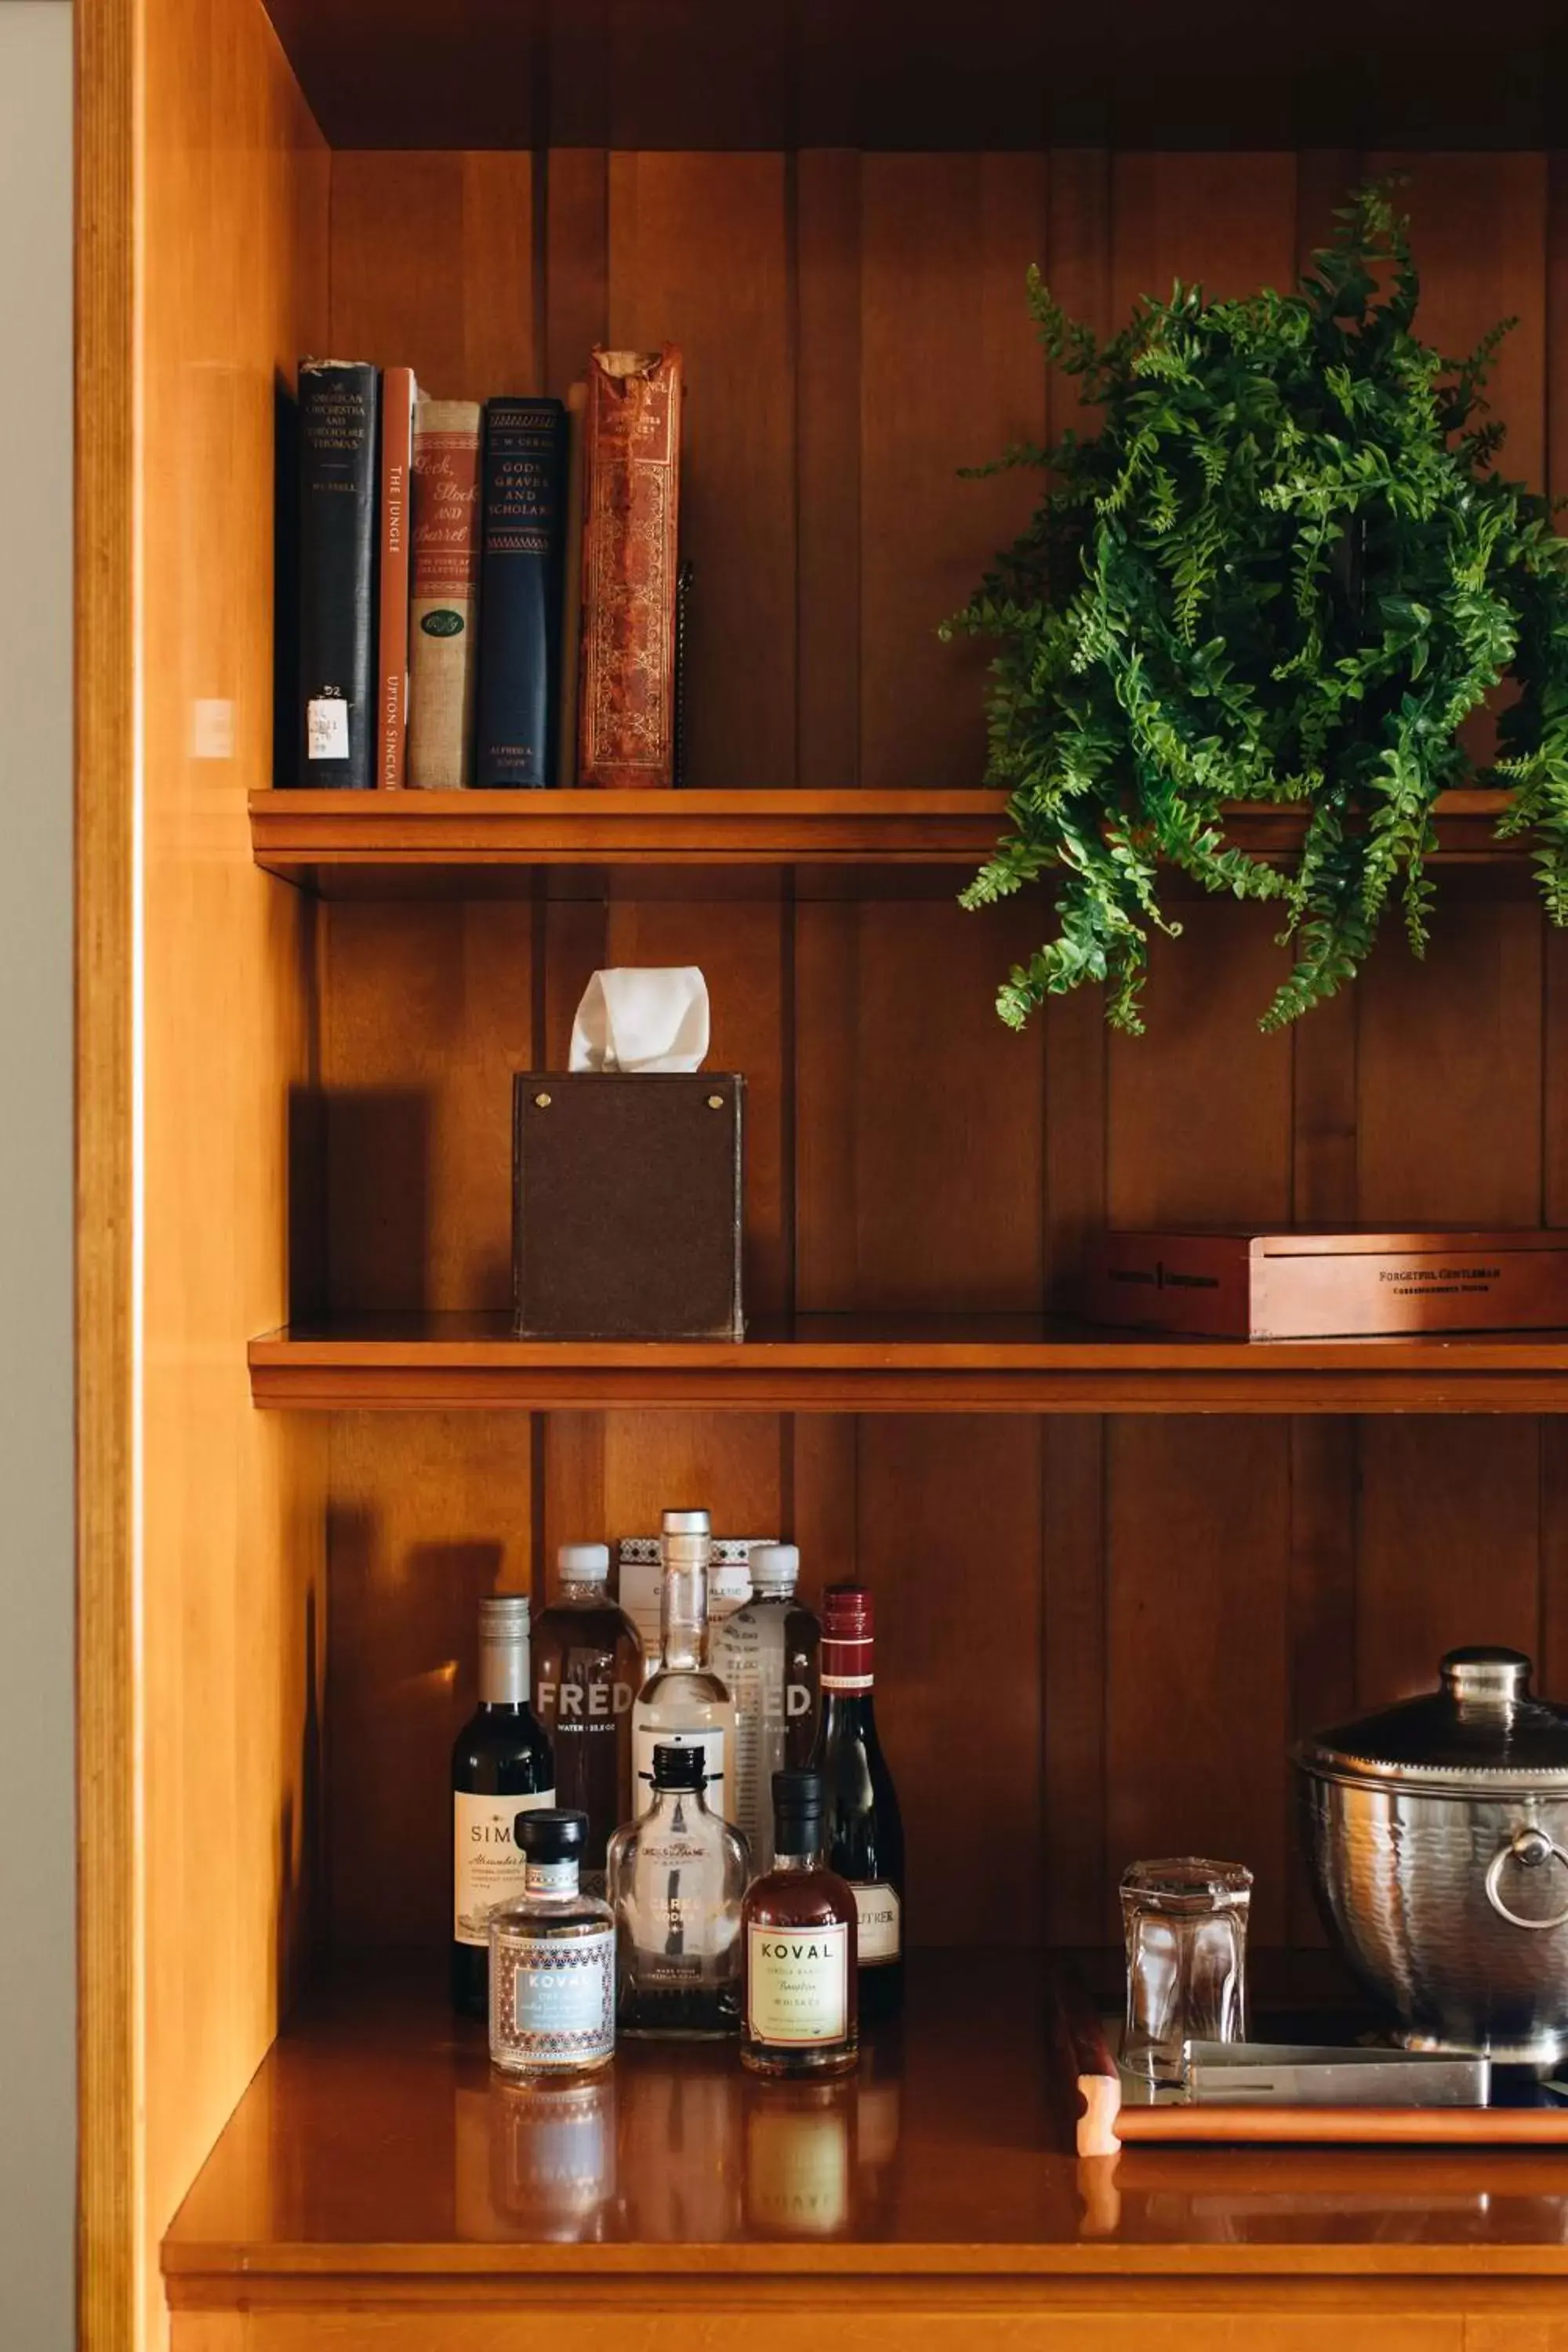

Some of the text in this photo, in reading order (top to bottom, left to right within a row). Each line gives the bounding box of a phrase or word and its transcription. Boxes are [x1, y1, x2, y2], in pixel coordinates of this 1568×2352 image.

[505, 490, 536, 501] AND
[389, 465, 402, 553] THE JUNGLE
[434, 507, 463, 519] AND
[387, 677, 398, 724] UPTON
[538, 1682, 632, 1715] FRED
[471, 1826, 510, 1842] SIM
[761, 1943, 833, 1958] KOVAL
[528, 1973, 590, 1989] KOVAL
